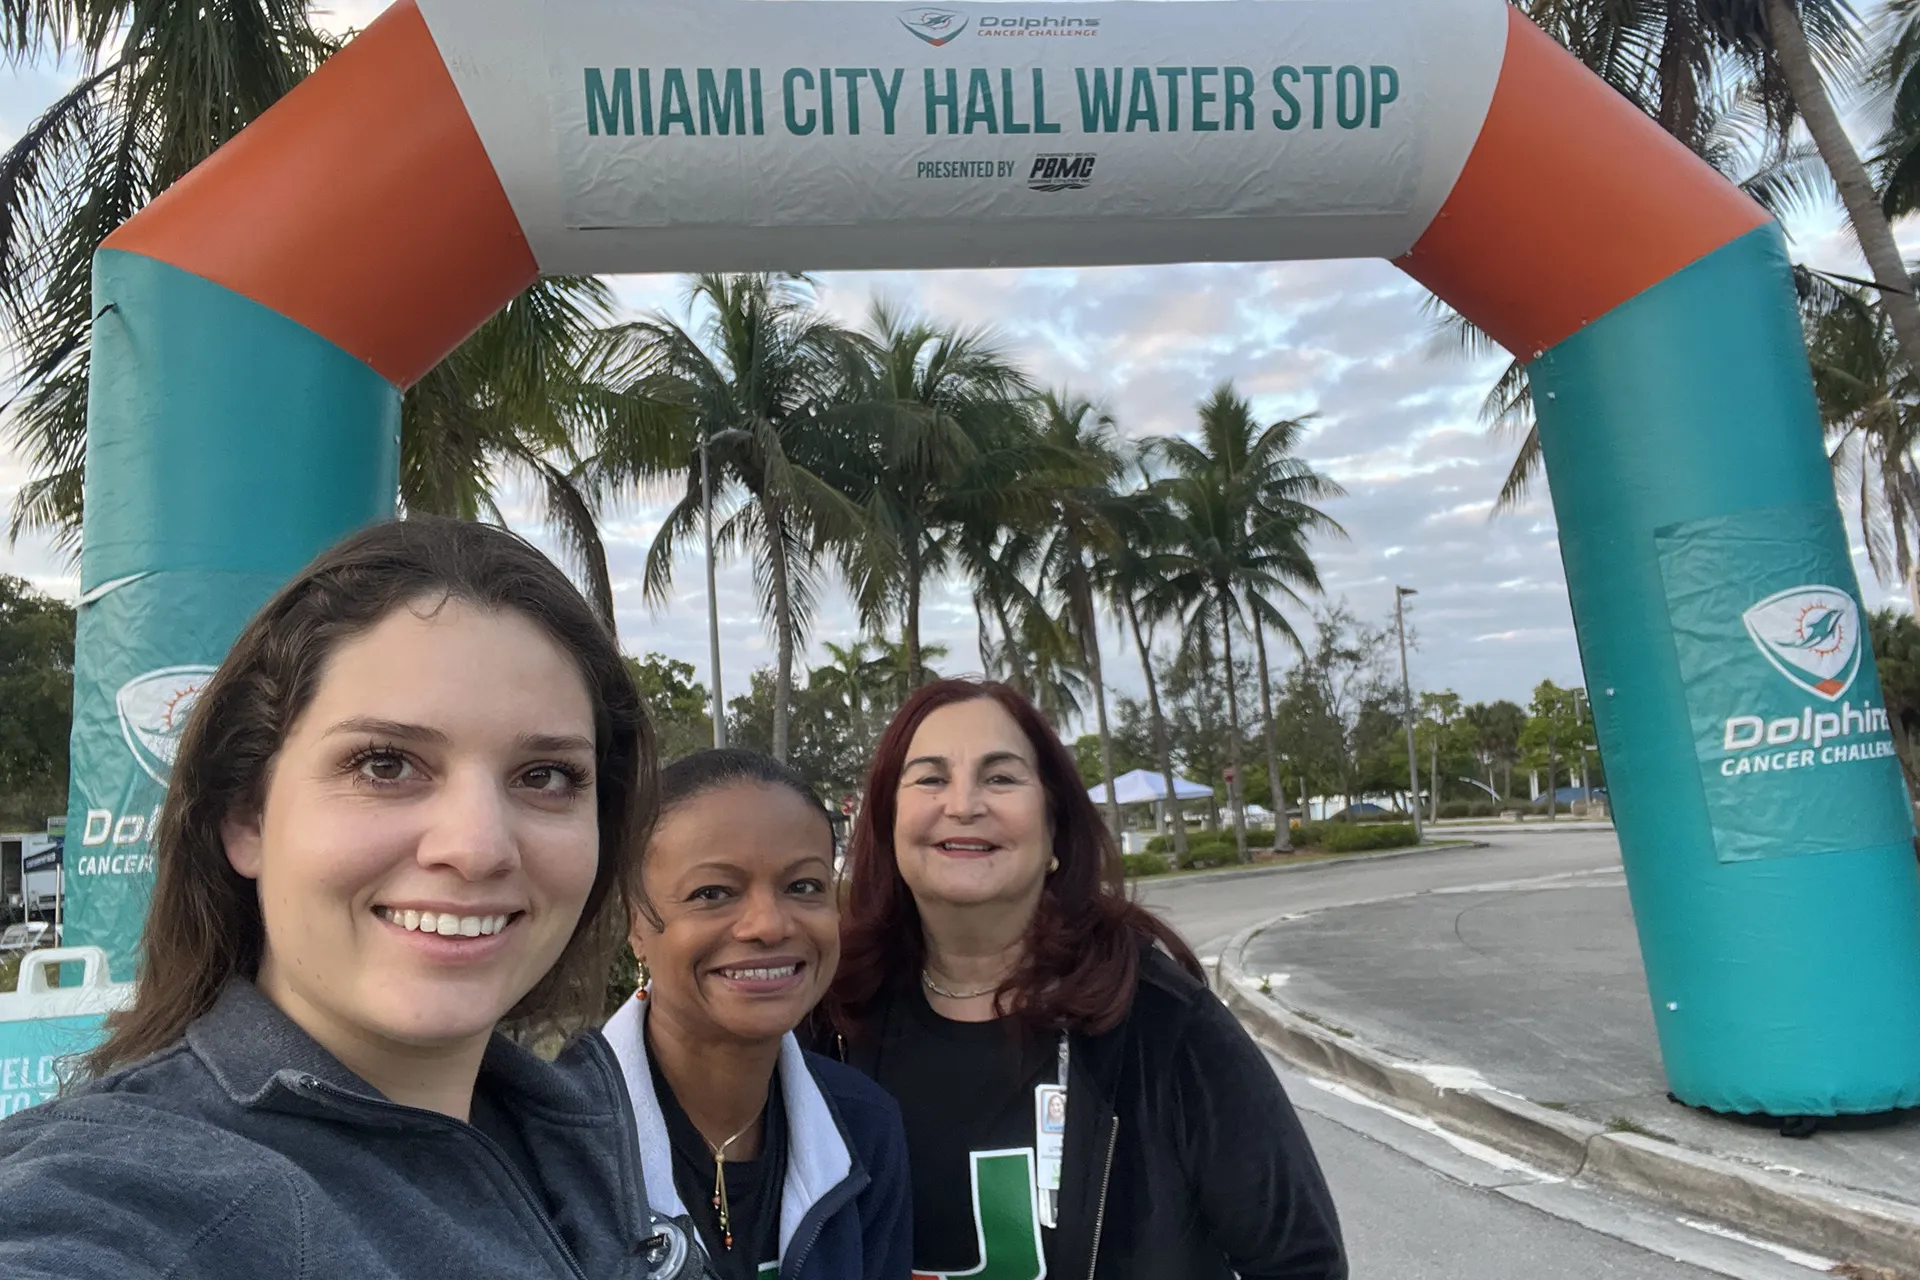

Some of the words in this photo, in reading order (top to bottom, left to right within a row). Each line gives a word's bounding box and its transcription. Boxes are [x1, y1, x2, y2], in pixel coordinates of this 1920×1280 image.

[977, 29, 1025, 37] CANCER
[1028, 29, 1098, 37] CHALLENGE
[979, 16, 1101, 30] Dolphins
[583, 67, 765, 136] MIAMI
[782, 67, 905, 136] CITY
[923, 67, 1062, 135] HALL
[1074, 66, 1255, 133] WATER
[1272, 65, 1400, 131] STOP
[916, 160, 994, 179] PRESENTED
[997, 160, 1015, 178] BY
[1029, 157, 1096, 179] PBMC
[1720, 750, 1815, 777] CANCER
[78, 854, 154, 876] CANCER
